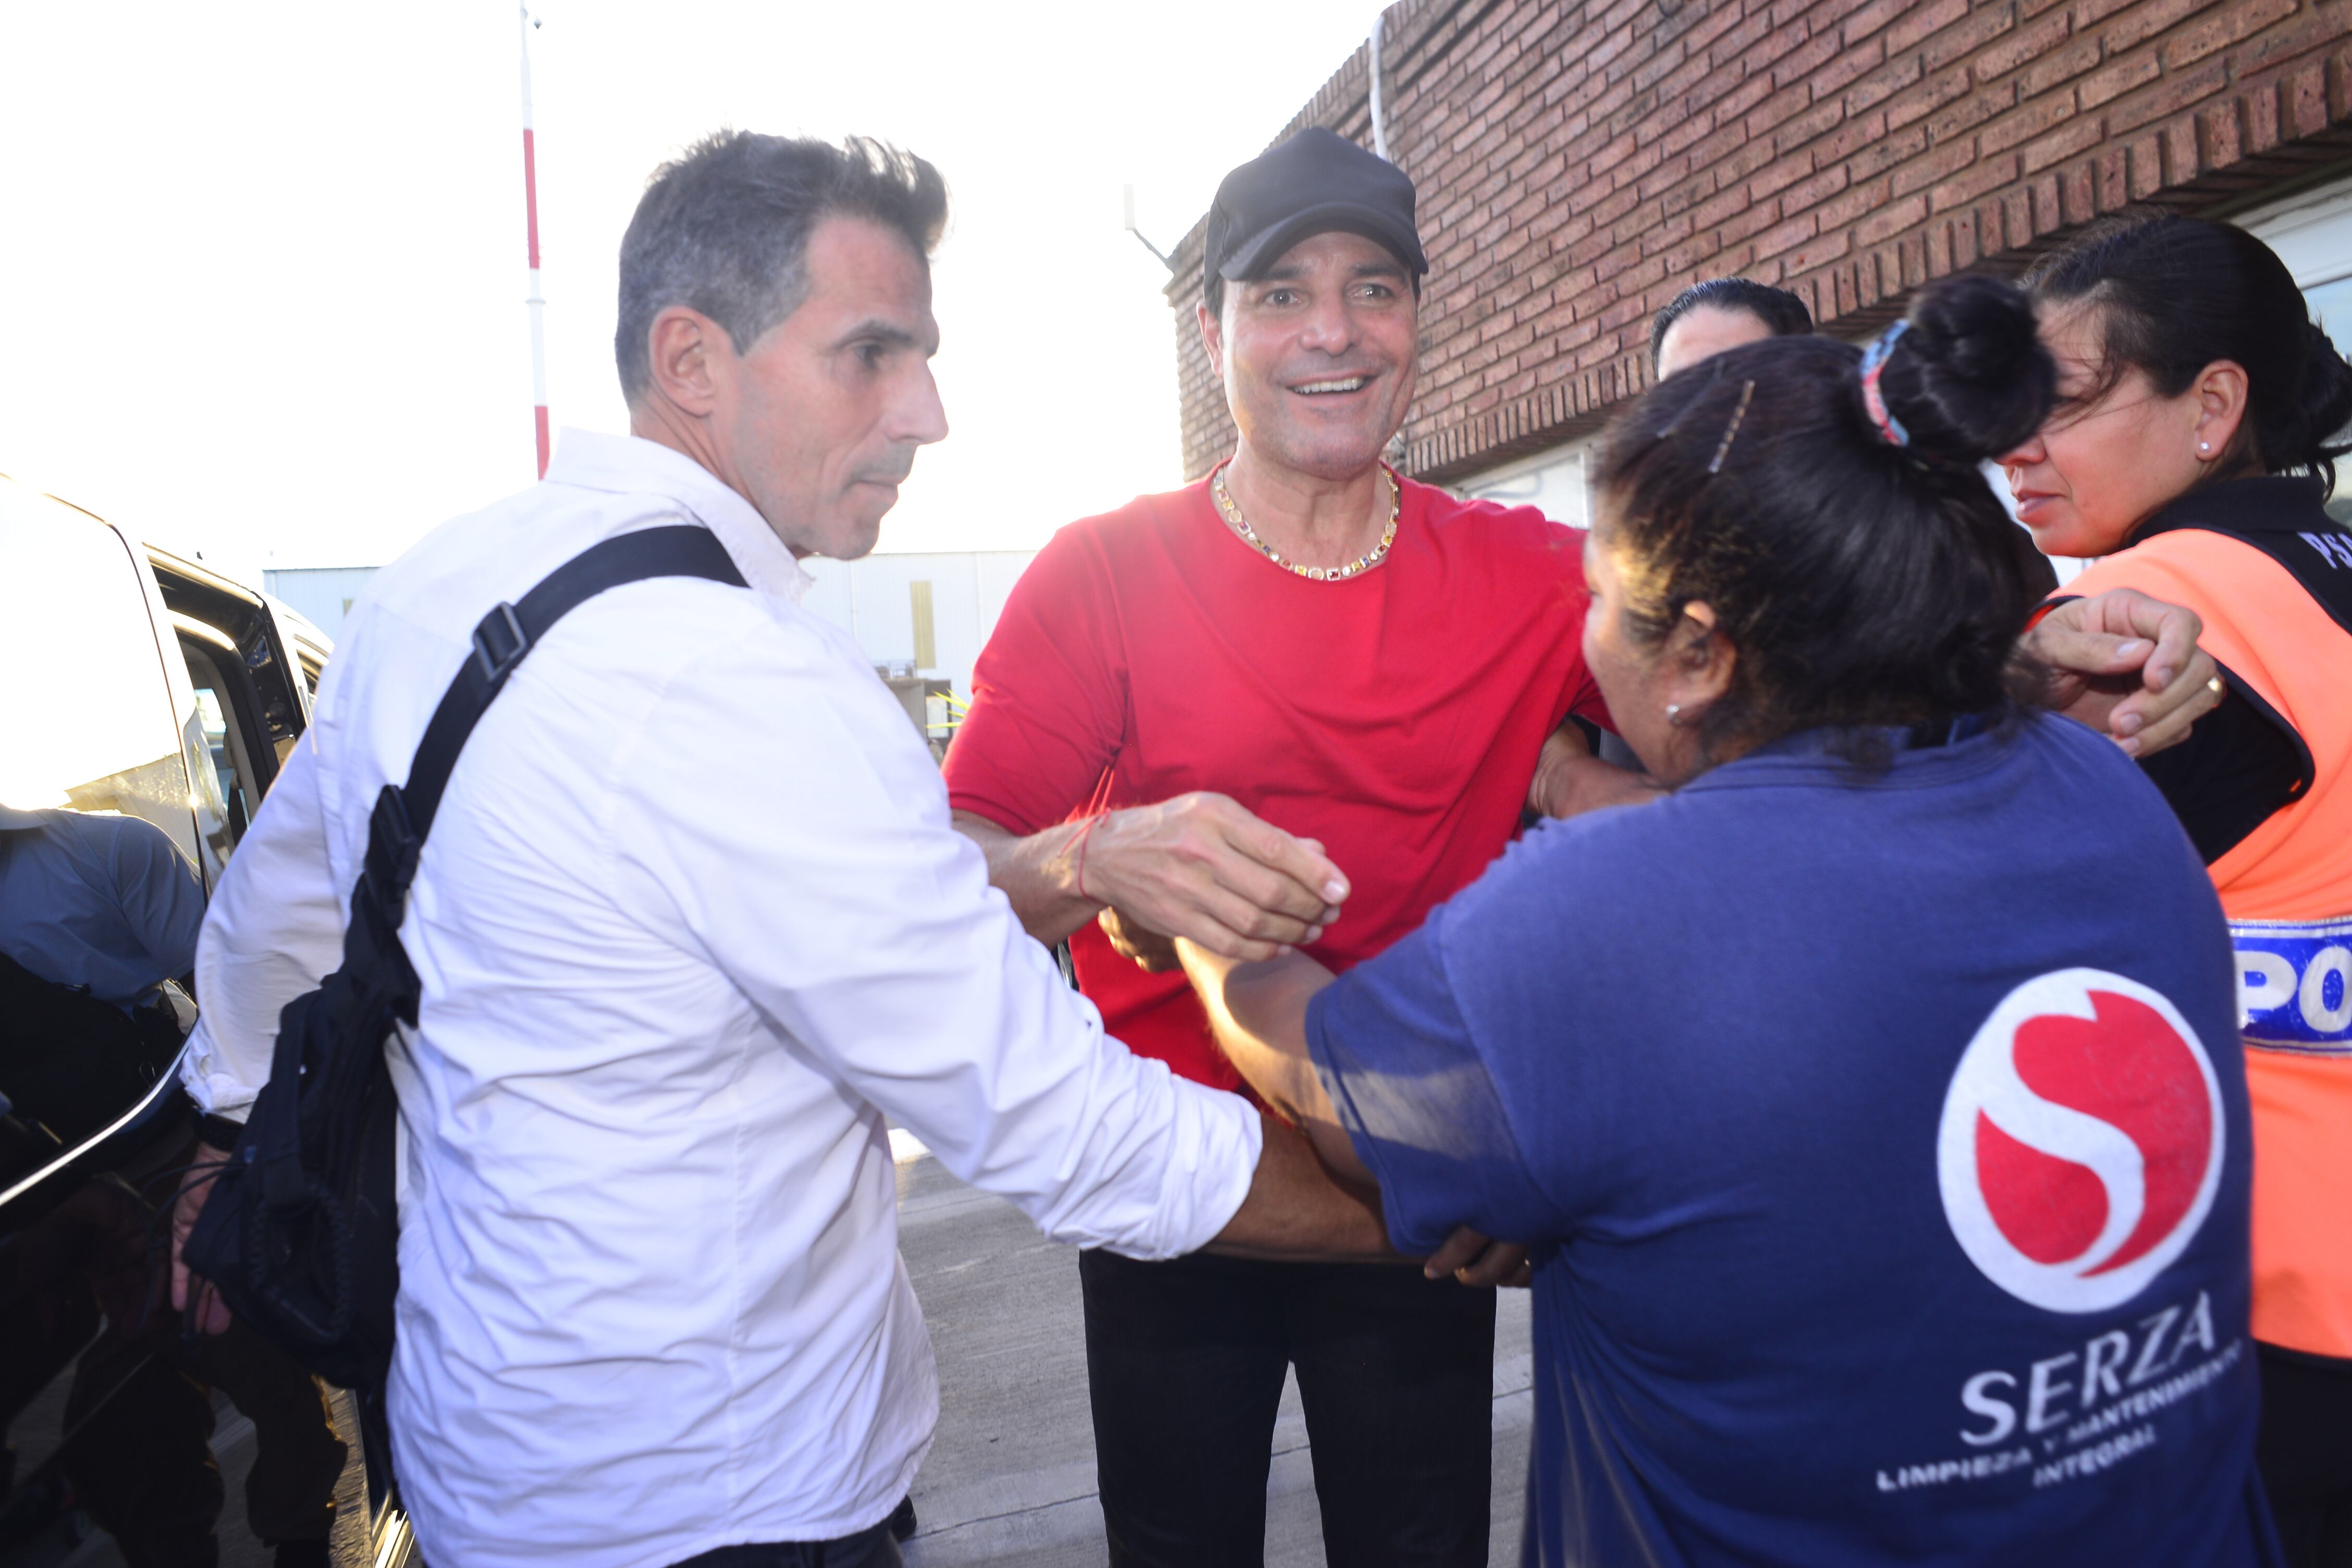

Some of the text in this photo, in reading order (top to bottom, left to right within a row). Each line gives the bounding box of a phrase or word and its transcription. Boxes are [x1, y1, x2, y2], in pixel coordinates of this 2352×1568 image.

[1959, 1290, 2215, 1446] SERZA
[1877, 1447, 2032, 1491] LIMPIEZA
[2032, 1424, 2156, 1488] INTEGRAL
